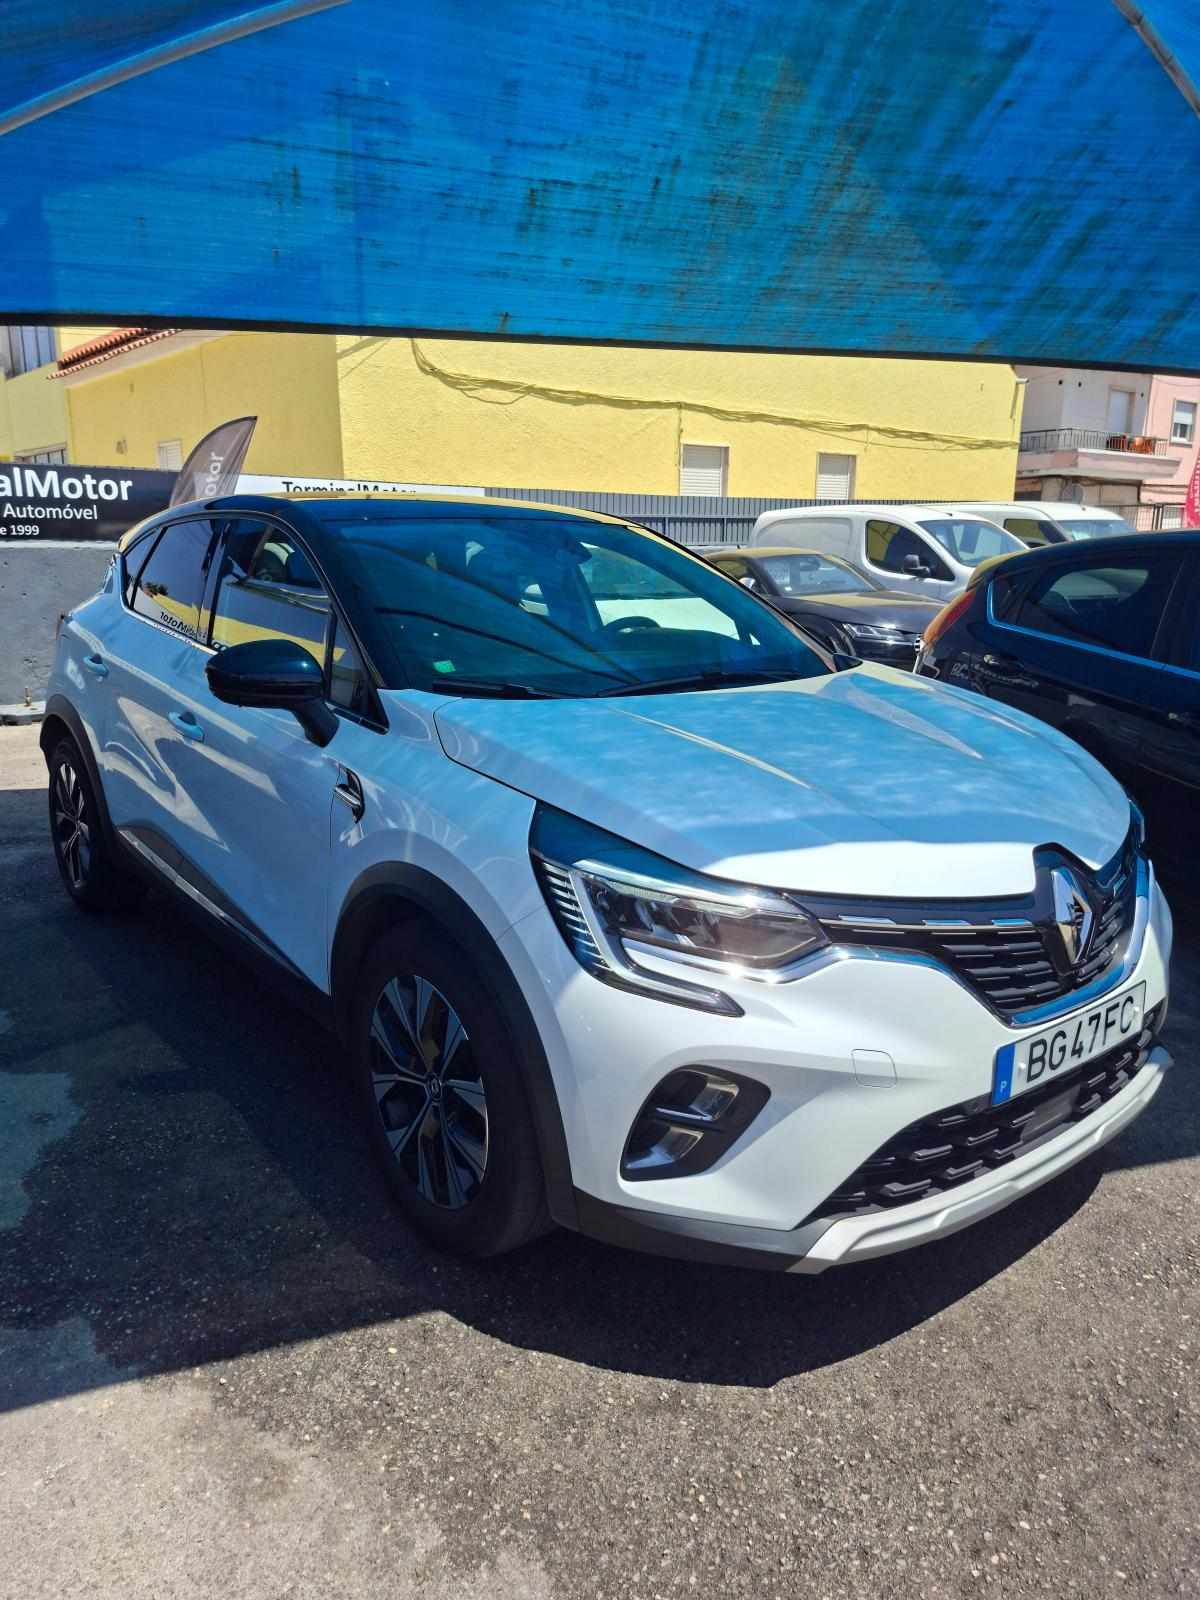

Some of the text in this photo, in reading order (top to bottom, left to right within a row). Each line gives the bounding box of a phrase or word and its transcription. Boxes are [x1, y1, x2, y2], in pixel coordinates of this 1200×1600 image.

[0, 466, 133, 501] alMotor
[3, 502, 98, 520] Automóvel
[10, 524, 40, 536] 1999
[1027, 995, 1134, 1082] BG47FC
